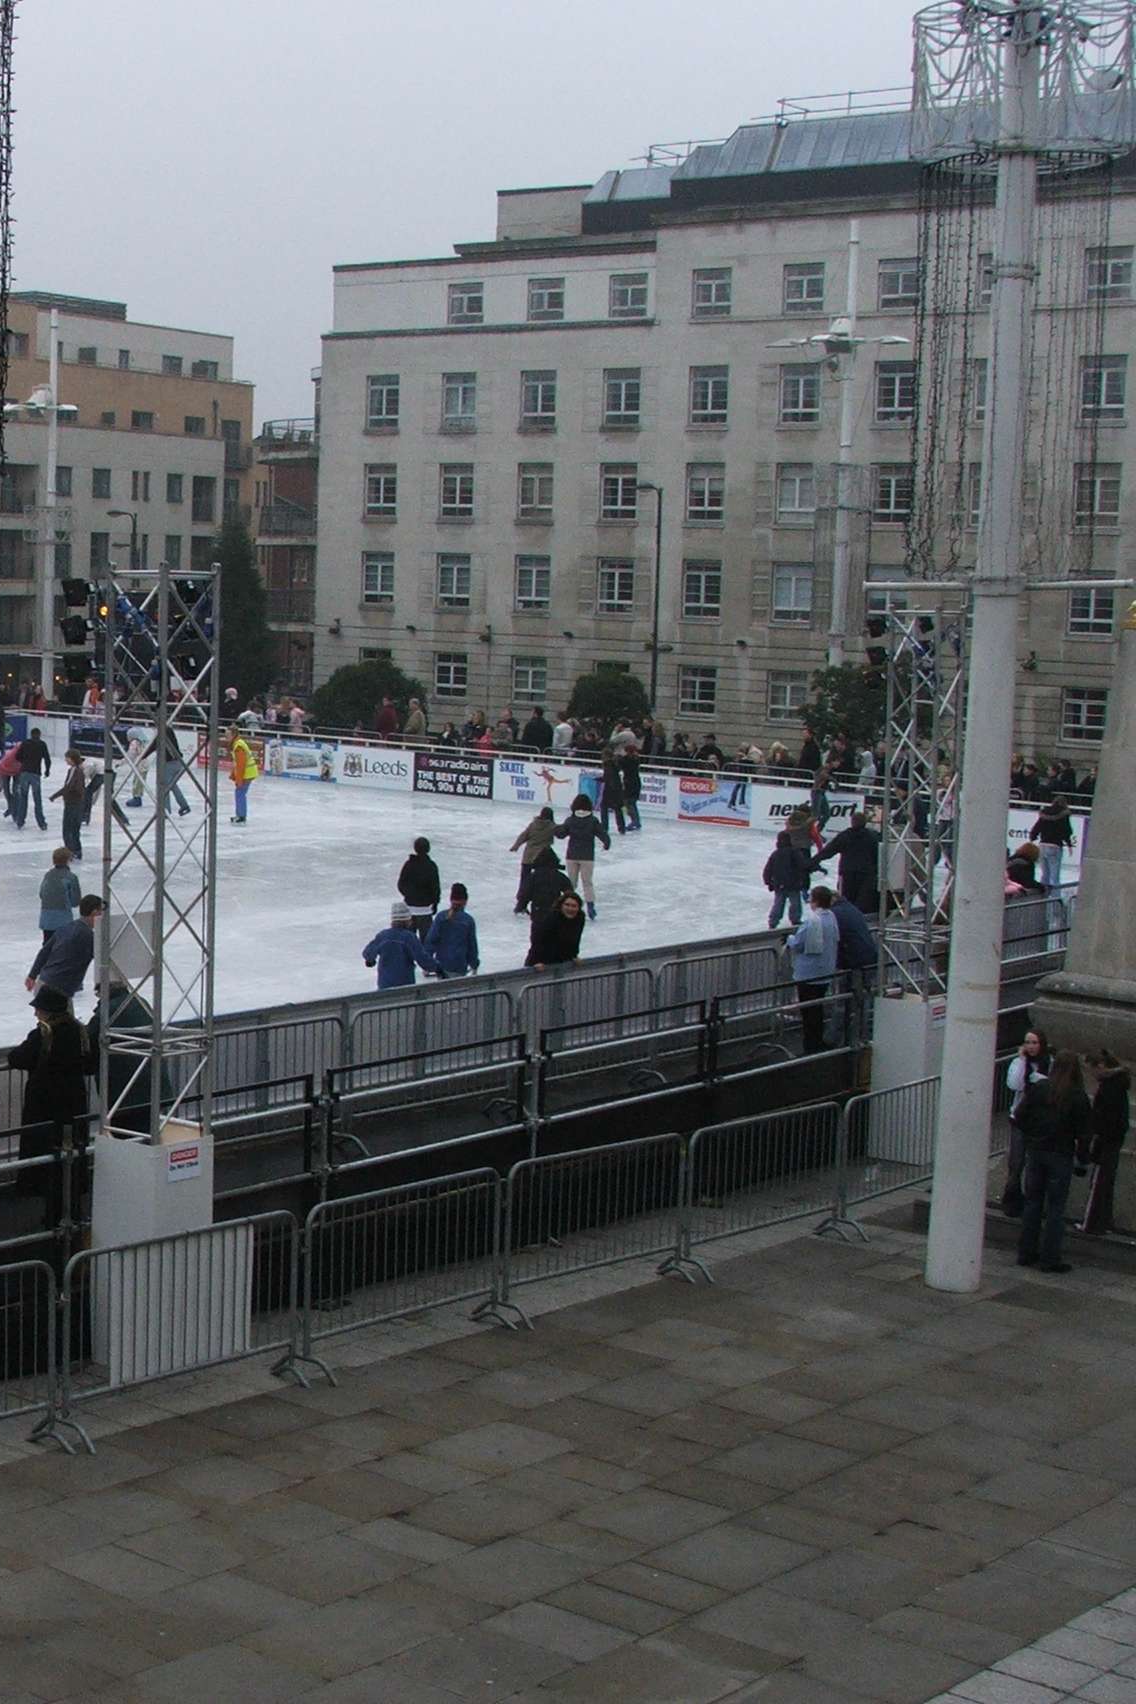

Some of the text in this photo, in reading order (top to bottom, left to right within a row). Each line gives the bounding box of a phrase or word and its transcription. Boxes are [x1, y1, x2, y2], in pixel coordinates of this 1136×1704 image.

[364, 758, 408, 776] Leeds
[499, 761, 524, 774] SKATE
[417, 770, 434, 781] THE
[435, 772, 457, 783] BEST
[459, 774, 471, 784] OF
[473, 776, 490, 786] THE
[511, 775, 529, 787] THIS
[437, 781, 454, 792] 90s
[456, 783, 464, 793] &
[466, 784, 489, 795] NOW
[517, 790, 535, 800] WAY
